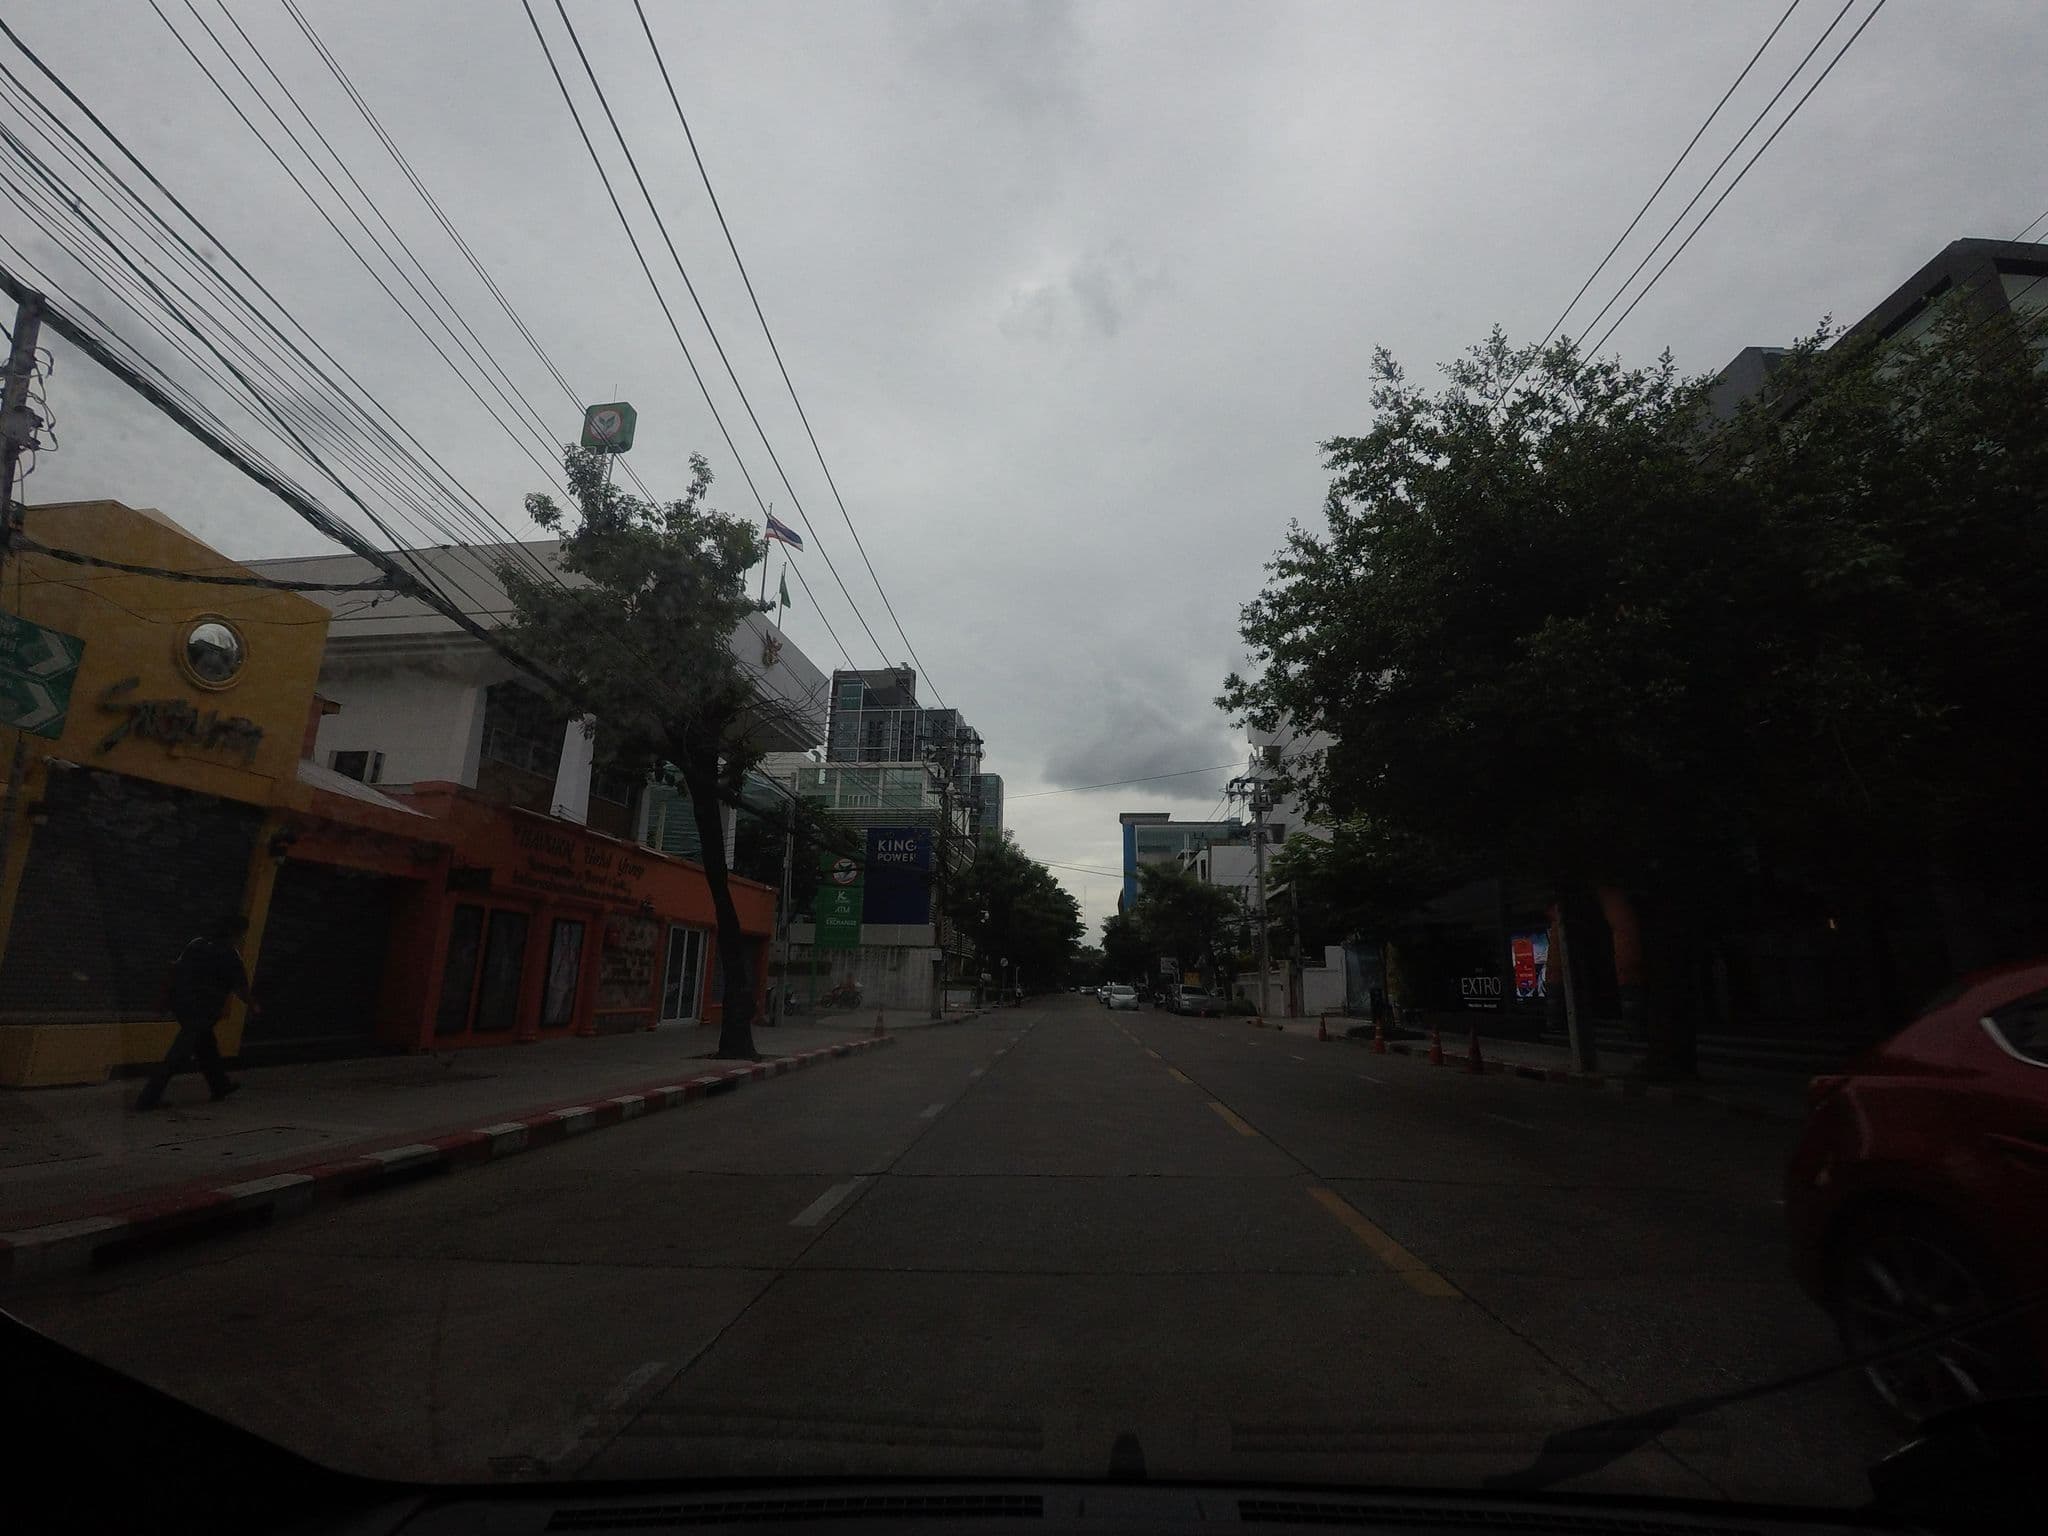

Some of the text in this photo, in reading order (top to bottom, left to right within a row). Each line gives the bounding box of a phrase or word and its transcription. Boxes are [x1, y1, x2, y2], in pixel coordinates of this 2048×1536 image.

[878, 840, 917, 852] KING
[878, 853, 917, 862] POWER
[1461, 976, 1502, 995] EXTRO
